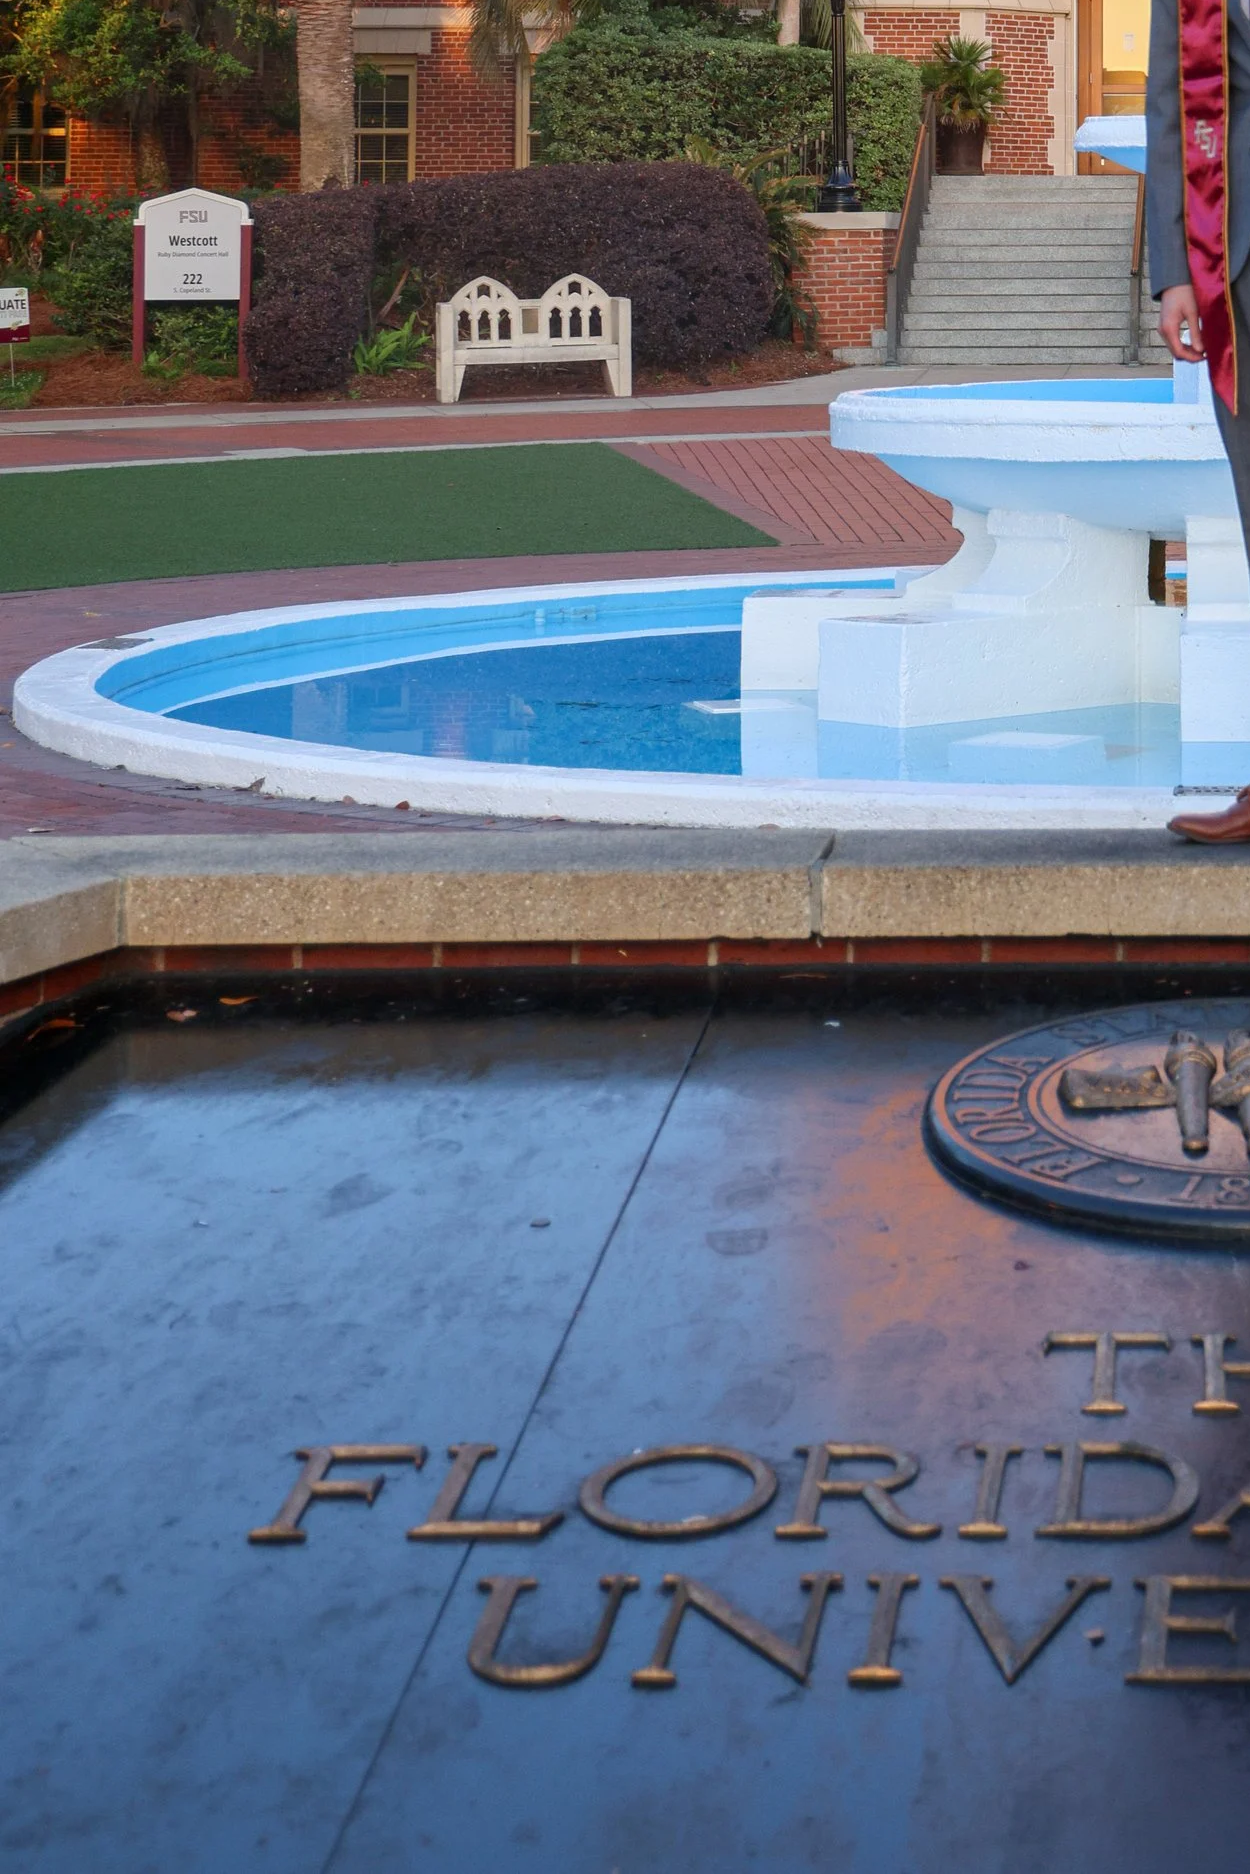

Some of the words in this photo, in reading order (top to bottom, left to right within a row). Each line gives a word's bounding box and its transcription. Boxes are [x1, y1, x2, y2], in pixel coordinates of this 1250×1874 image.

[1194, 119, 1217, 158] FSU
[179, 210, 208, 223] FSU
[168, 235, 218, 246] Westcott
[183, 273, 202, 284] 222
[952, 1056, 1108, 1183] FLORIDA
